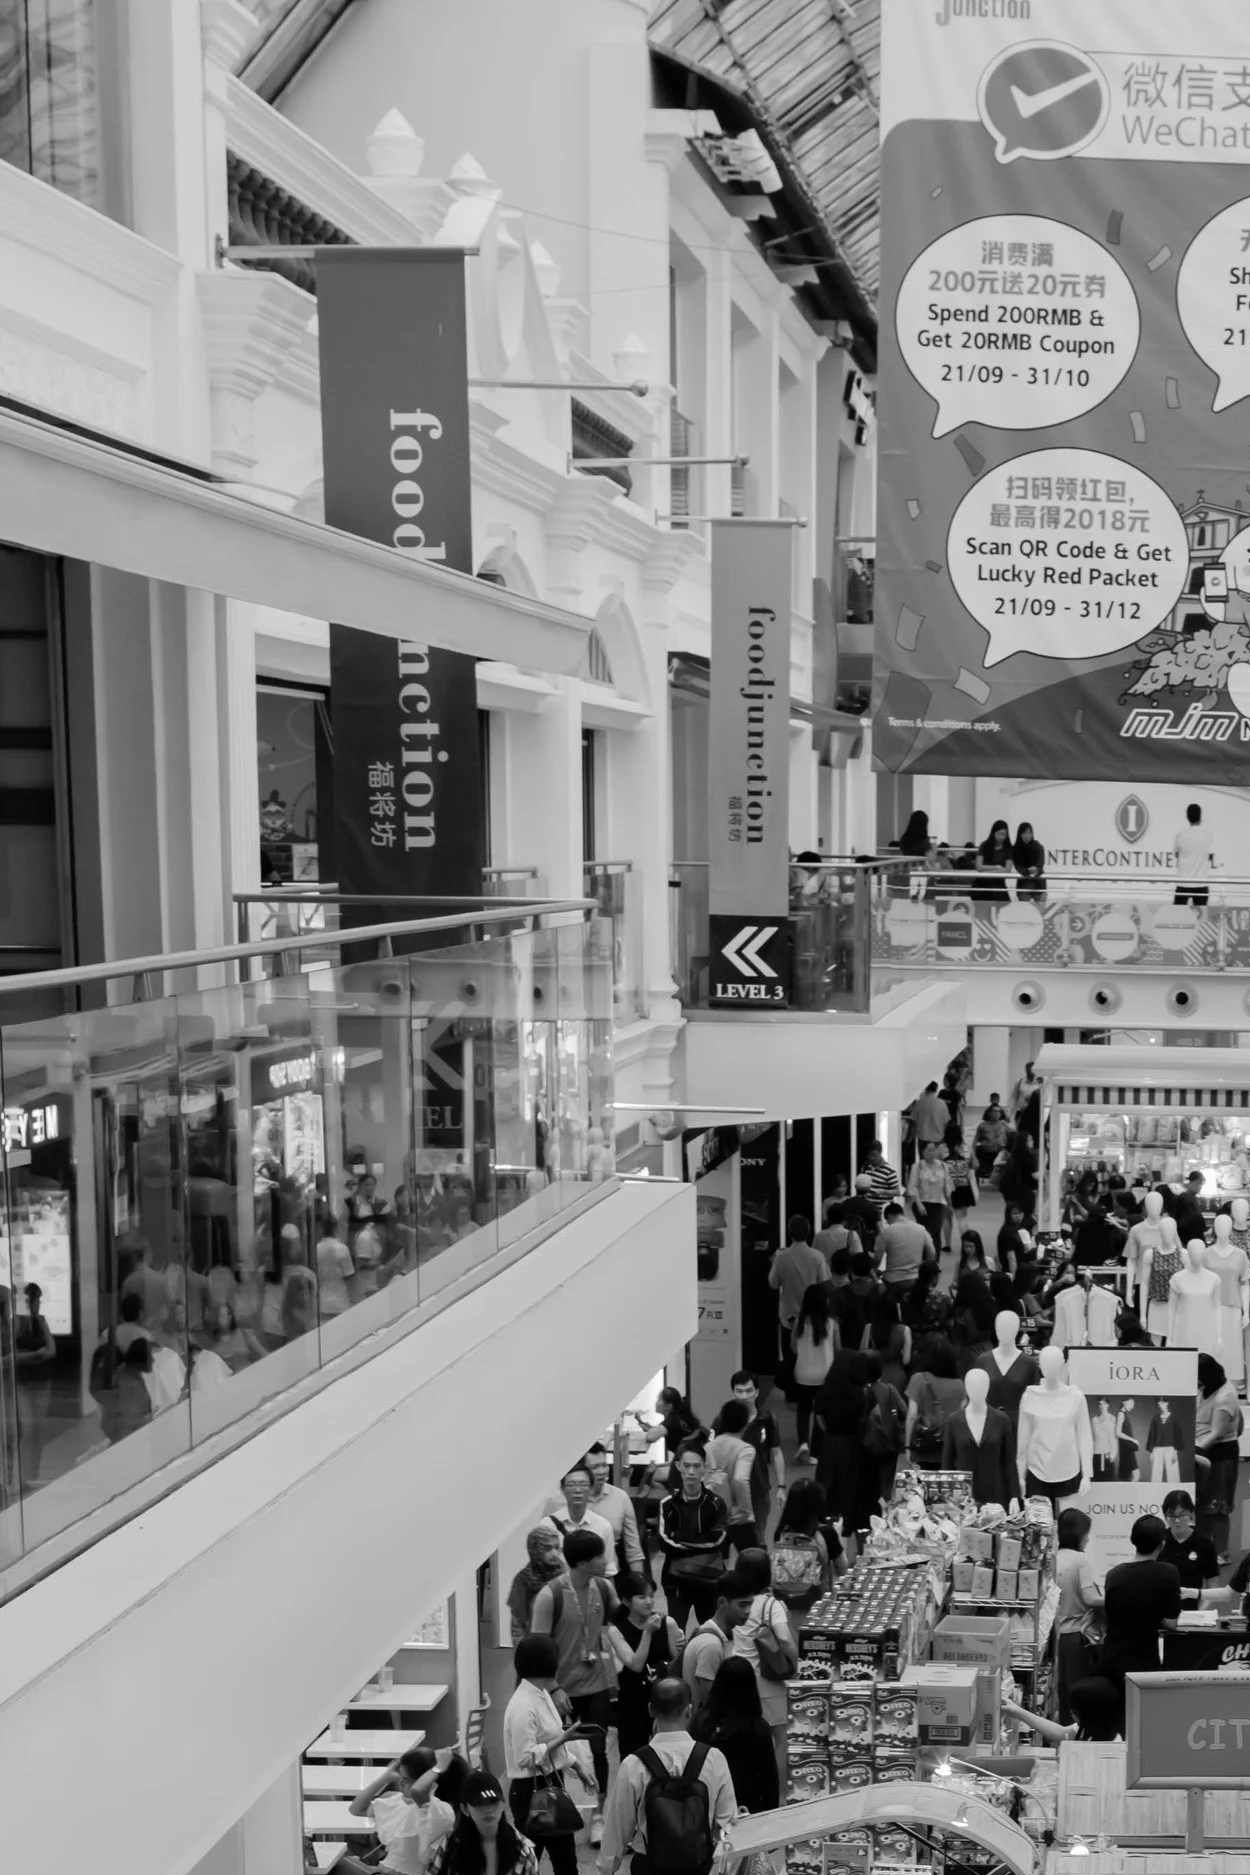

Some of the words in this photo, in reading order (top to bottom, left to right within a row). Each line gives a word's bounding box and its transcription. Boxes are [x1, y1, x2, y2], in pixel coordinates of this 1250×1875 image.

[981, 241, 1054, 267] 消费满
[928, 303, 989, 326] Spend
[997, 305, 1081, 327] 200RMB
[1089, 310, 1104, 327] &
[917, 329, 951, 348] Get
[961, 332, 1032, 350] 20RMB
[1039, 335, 1115, 358] Coupon
[941, 364, 1004, 384] 21/09
[1027, 367, 1090, 387] 31/10
[989, 503, 1151, 533] 最高得2018元
[966, 537, 1012, 555] Scan
[1019, 539, 1048, 559] QR
[1056, 541, 1107, 559] Code
[1114, 543, 1129, 560] &
[1137, 543, 1172, 562] Get
[977, 564, 1036, 587] Lucky
[1043, 567, 1082, 584] Red
[1089, 568, 1159, 587] Packet
[994, 598, 1056, 617] 21/09
[1080, 600, 1141, 620] 31/12
[740, 606, 775, 845] foodjunction
[924, 718, 972, 731] conditions
[716, 983, 772, 999] LEVEL
[773, 985, 784, 1000] 3
[738, 1157, 767, 1167] ONY
[1109, 1362, 1161, 1381] iORA
[1085, 1503, 1116, 1515] JOIN
[1120, 1503, 1136, 1515] US
